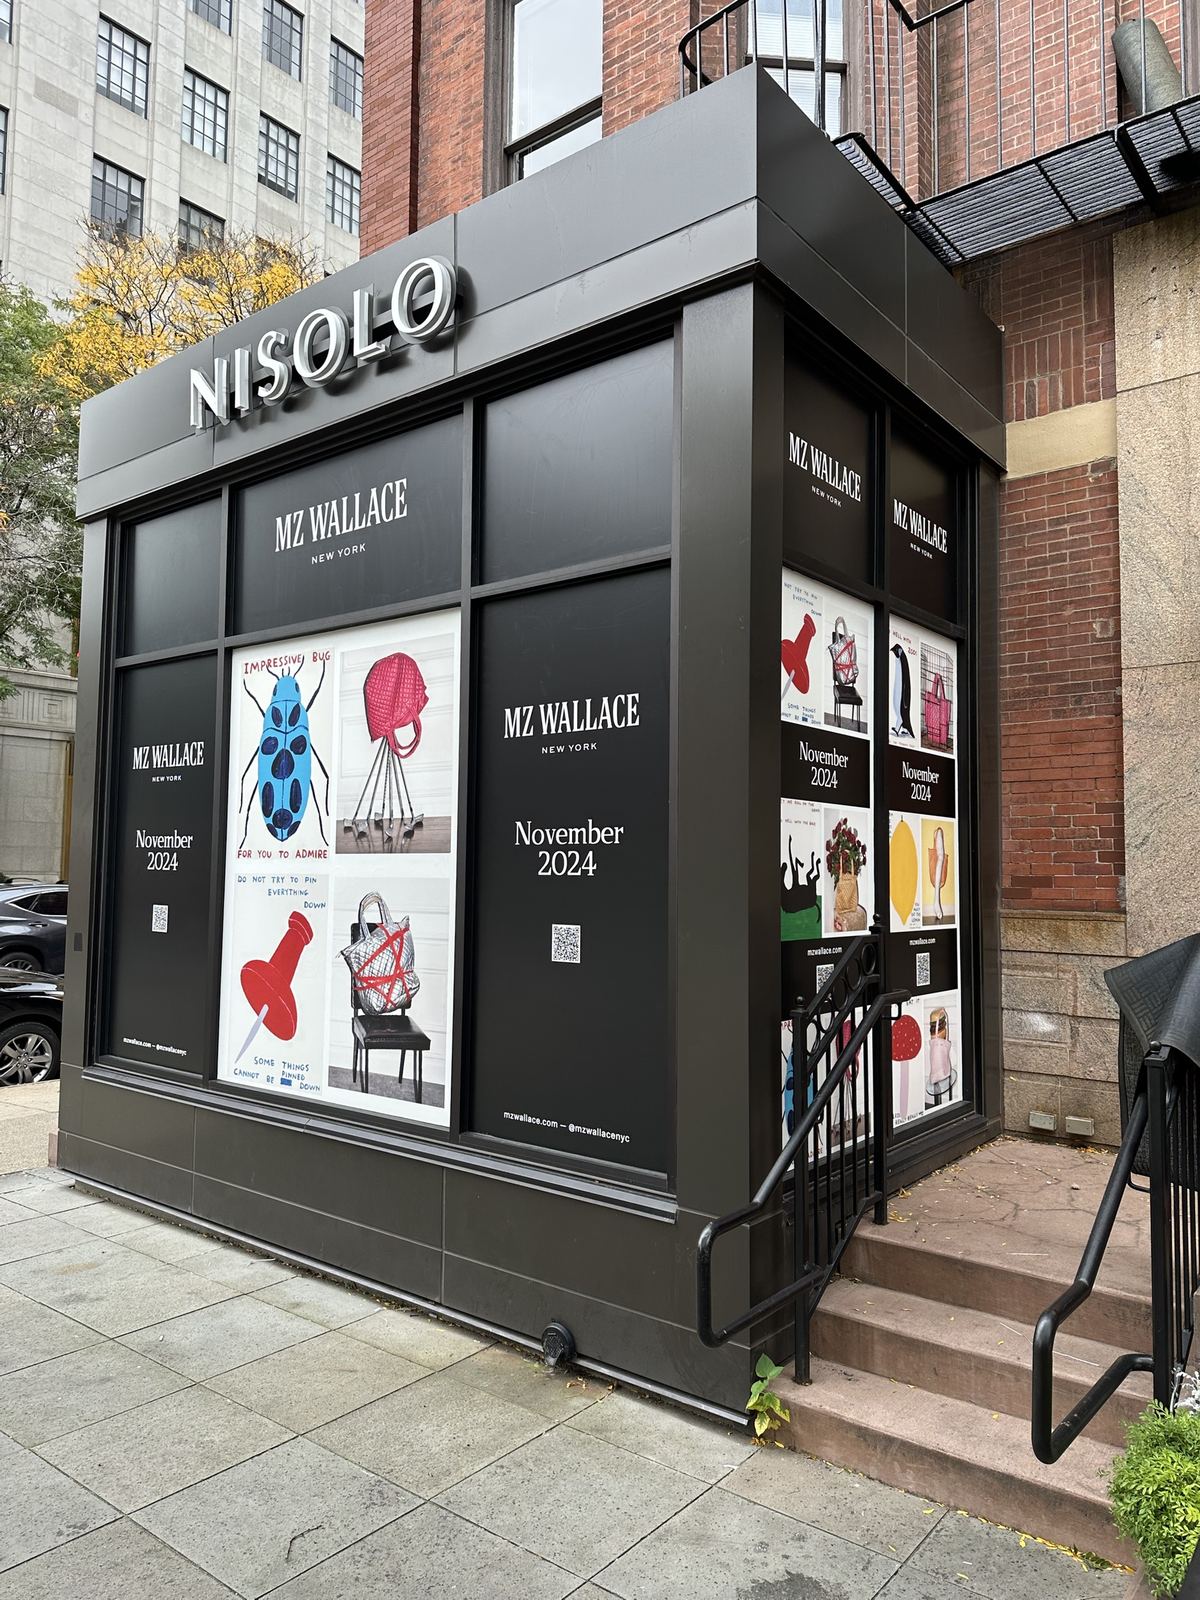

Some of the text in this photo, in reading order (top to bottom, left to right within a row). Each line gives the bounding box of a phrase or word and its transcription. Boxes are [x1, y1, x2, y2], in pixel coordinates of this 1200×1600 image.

[190, 256, 456, 429] NISOLO
[789, 431, 861, 502] MZ WALLACE
[811, 485, 842, 508] NEW YORK
[274, 478, 408, 552] MZ WALLACE
[893, 498, 948, 554] MZ WALLACE
[311, 543, 367, 565] NEW YORK
[910, 542, 933, 560] NEW YORK
[243, 650, 331, 675] IMPRESSIVE BUG
[503, 692, 641, 739] MZ WALLACE
[132, 741, 205, 770] MZ WALLACE
[541, 742, 598, 754] NEW YORK
[799, 740, 849, 768] November
[810, 766, 838, 789] 2024
[902, 761, 940, 784] November
[910, 782, 932, 802] 2024
[135, 829, 193, 849] November
[514, 819, 624, 846] November
[147, 851, 179, 871] 2024
[237, 848, 328, 860] FOR YOU TO ADMIRE
[537, 850, 597, 876] 2024
[237, 875, 317, 884] DO NOT TRY TO PIN
[267, 888, 309, 896] EVERYTHING
[303, 901, 327, 910] DOWN
[807, 945, 843, 957] mzwallace.com
[909, 937, 936, 946] mzwallace.com
[253, 1056, 310, 1072] SOME THINGS
[233, 1068, 321, 1092] CANNOT BE PINNED DOWN
[503, 1111, 559, 1128] mzwallace.com
[568, 1123, 630, 1143] @mzwallacenyc
